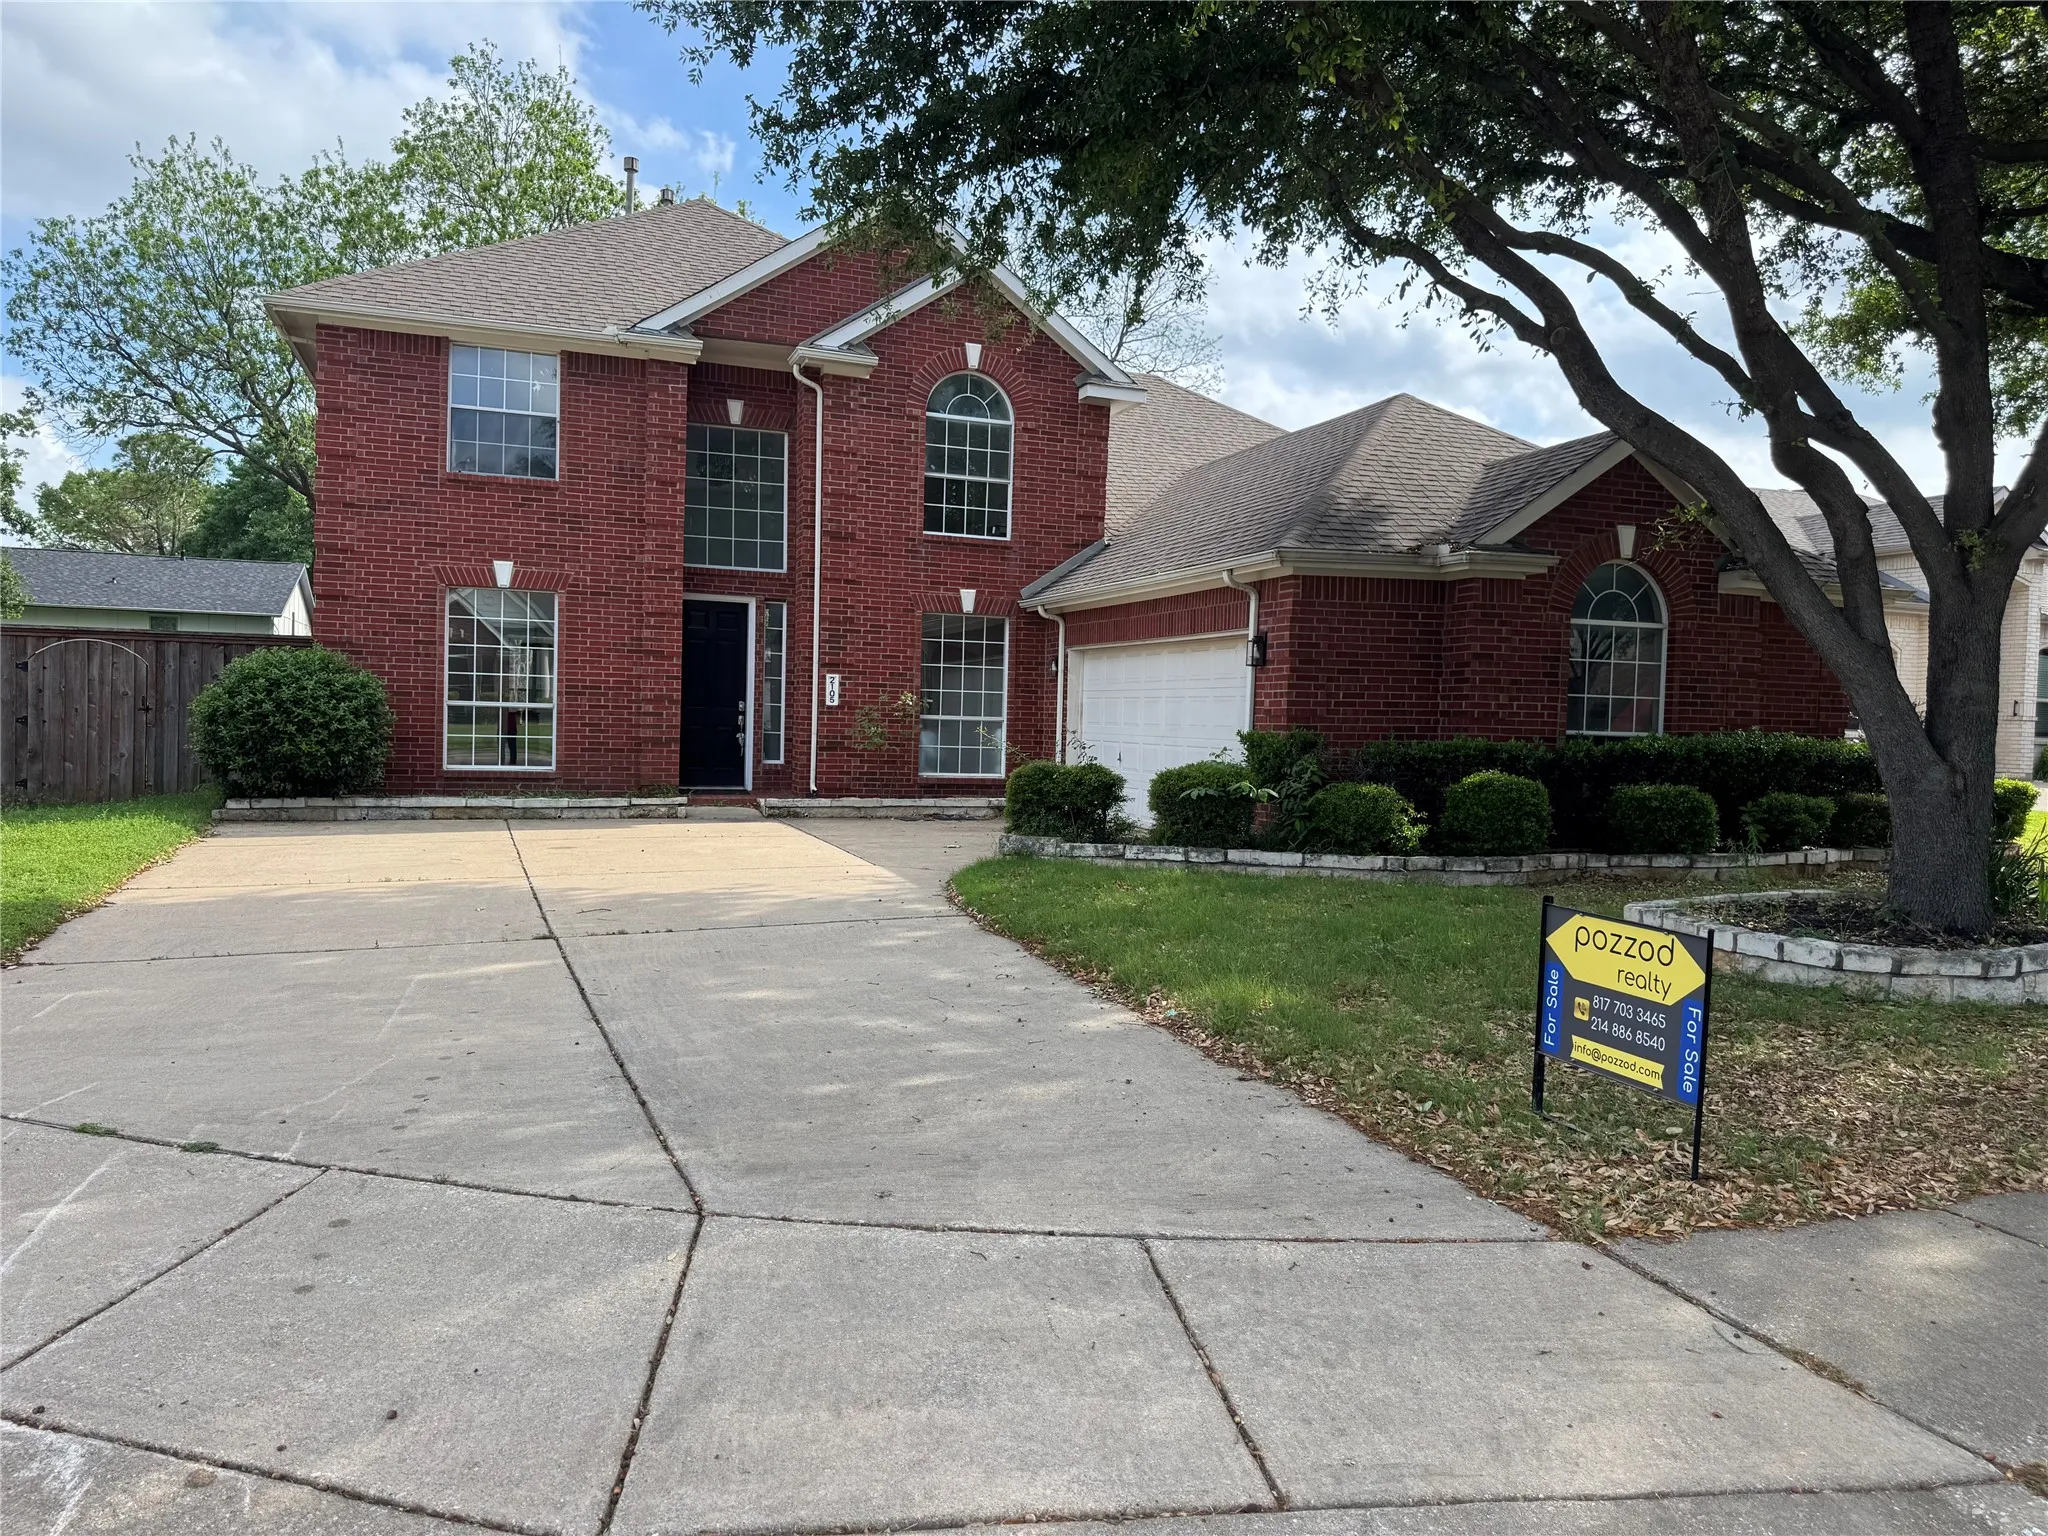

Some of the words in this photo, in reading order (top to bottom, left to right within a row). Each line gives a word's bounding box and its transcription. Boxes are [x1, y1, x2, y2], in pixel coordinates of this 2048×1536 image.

[1575, 926, 1675, 967] pozzod
[1546, 969, 1559, 1009] Sale
[1617, 968, 1672, 1001] realty
[1544, 1013, 1557, 1046] For
[1592, 995, 1610, 1012] 817
[1613, 1001, 1634, 1019] 703
[1636, 1007, 1666, 1029] 3465
[1686, 1006, 1702, 1044] For
[1590, 1016, 1608, 1034] 214
[1611, 1022, 1632, 1041] 886
[1635, 1030, 1666, 1052] 8540
[1574, 1041, 1661, 1081] info@pozzod.com
[1682, 1048, 1698, 1093] Sale
